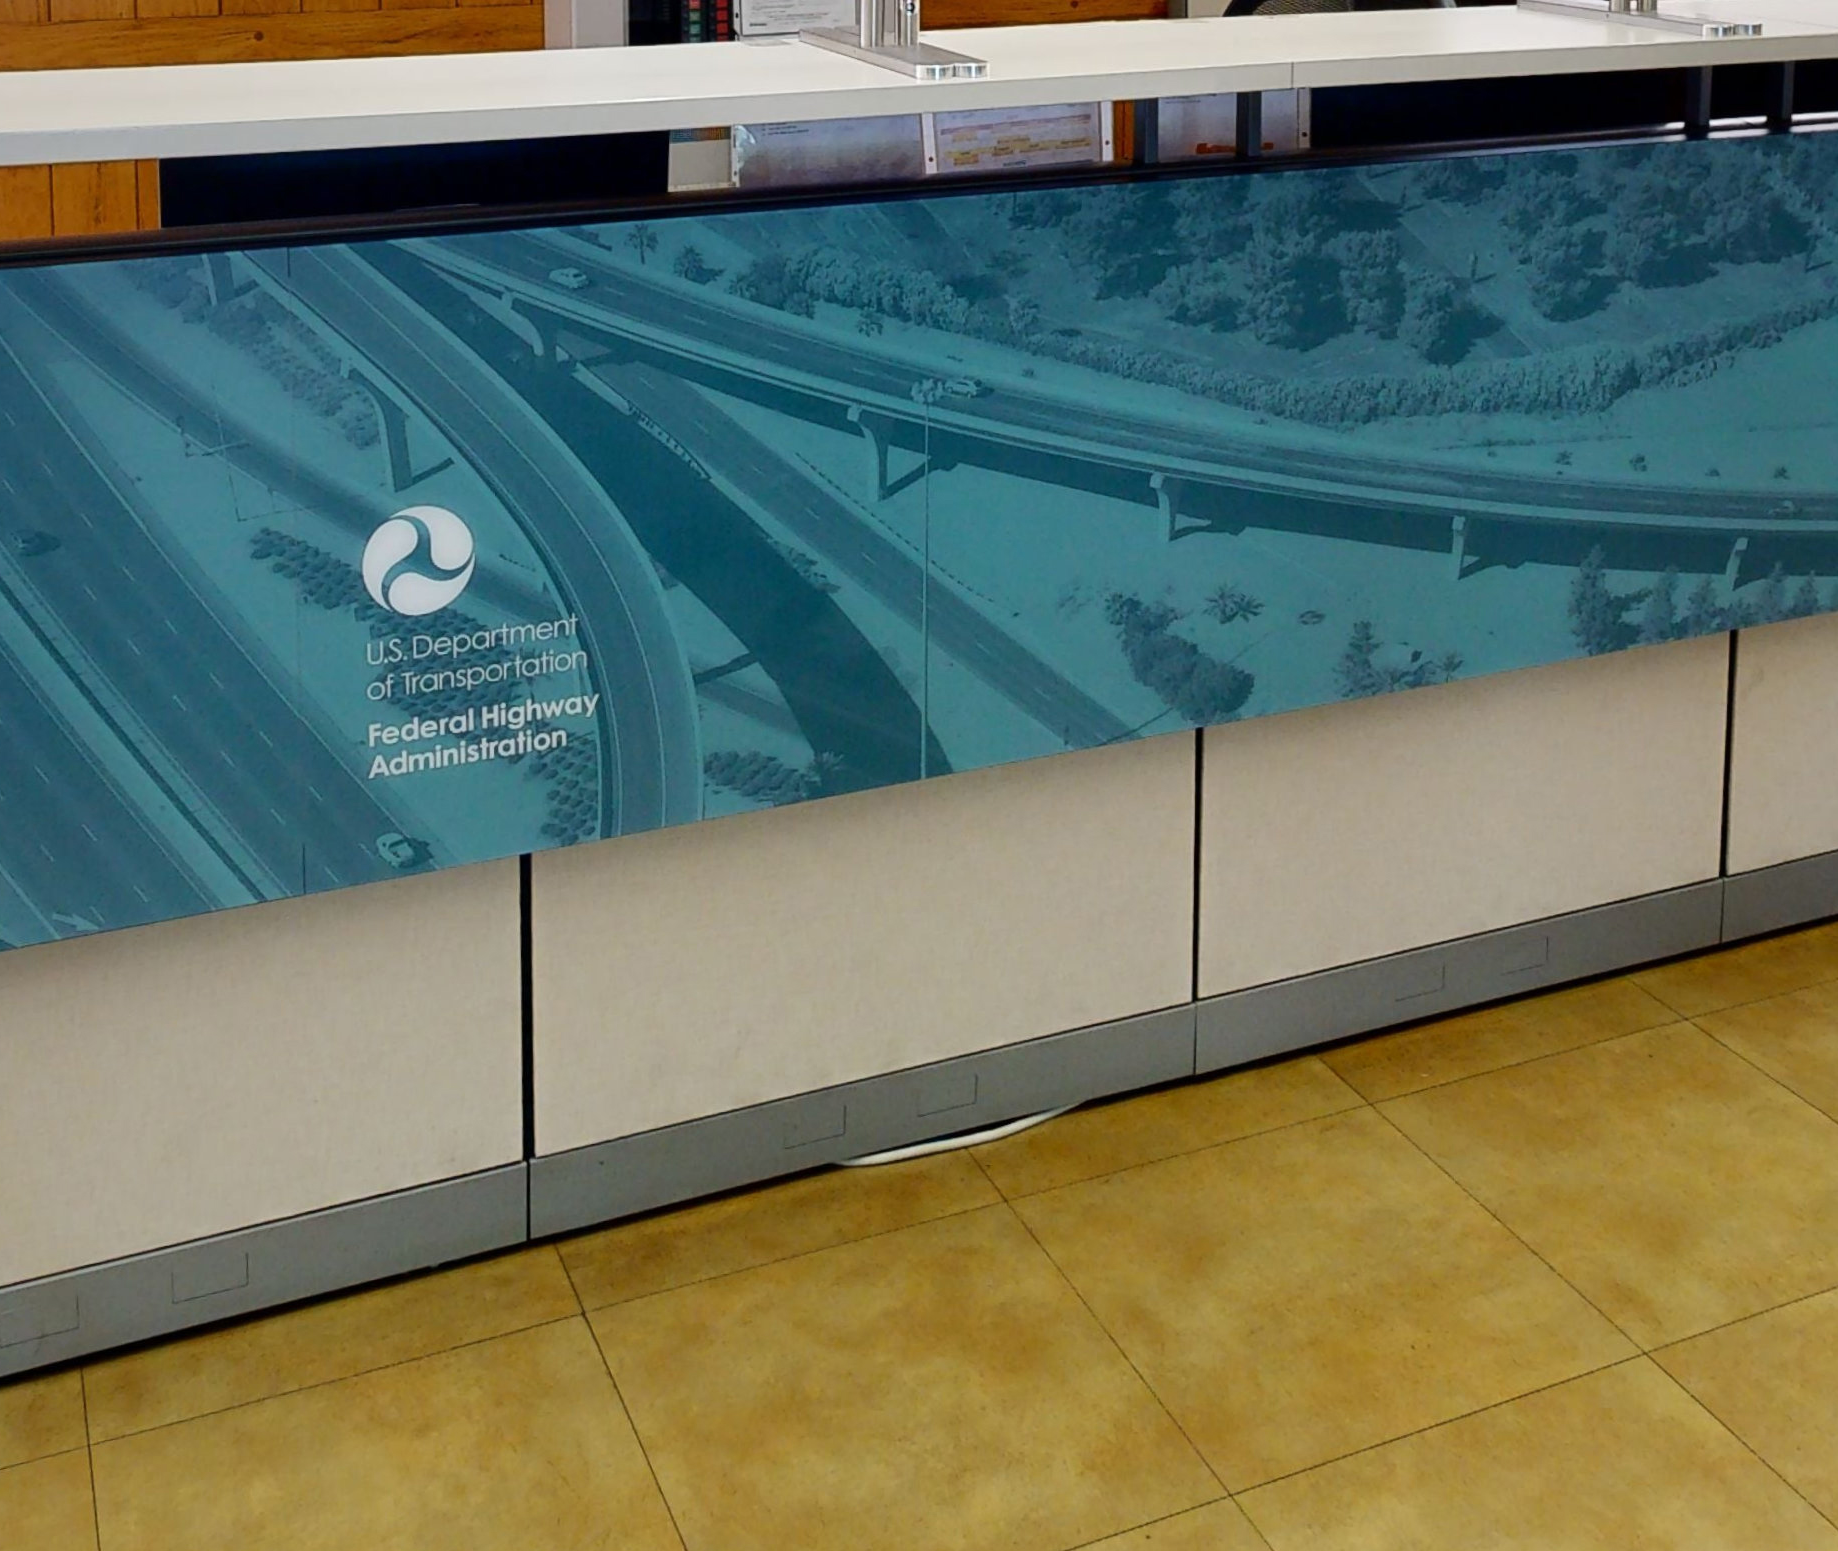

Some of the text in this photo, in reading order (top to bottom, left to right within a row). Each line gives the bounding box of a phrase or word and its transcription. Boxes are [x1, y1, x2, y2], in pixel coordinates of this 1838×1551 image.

[366, 613, 578, 665] U.S. Department
[366, 650, 588, 700] of Transportation
[368, 693, 599, 748] Federal Highway
[368, 729, 568, 779] Administration
